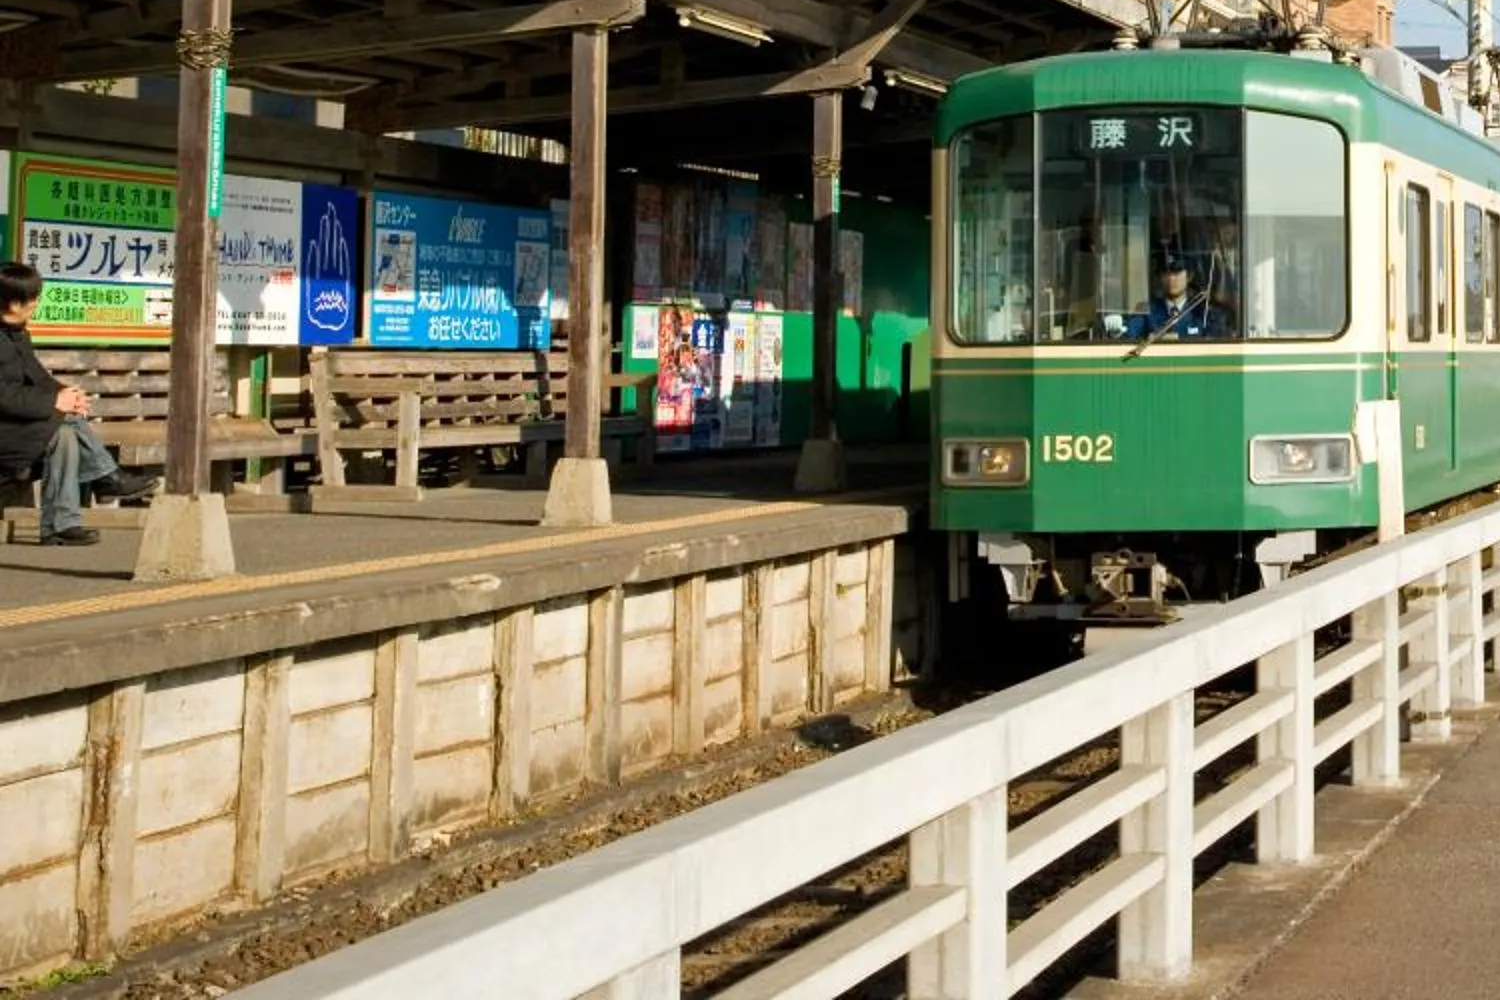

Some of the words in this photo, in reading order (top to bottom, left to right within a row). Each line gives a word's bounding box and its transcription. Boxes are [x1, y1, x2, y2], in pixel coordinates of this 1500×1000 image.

[1090, 117, 1192, 149] 藤沢
[28, 227, 62, 249] 貴金属
[66, 231, 153, 277] ツルヤ
[428, 316, 501, 342] お任せください
[1043, 434, 1113, 462] 1502
